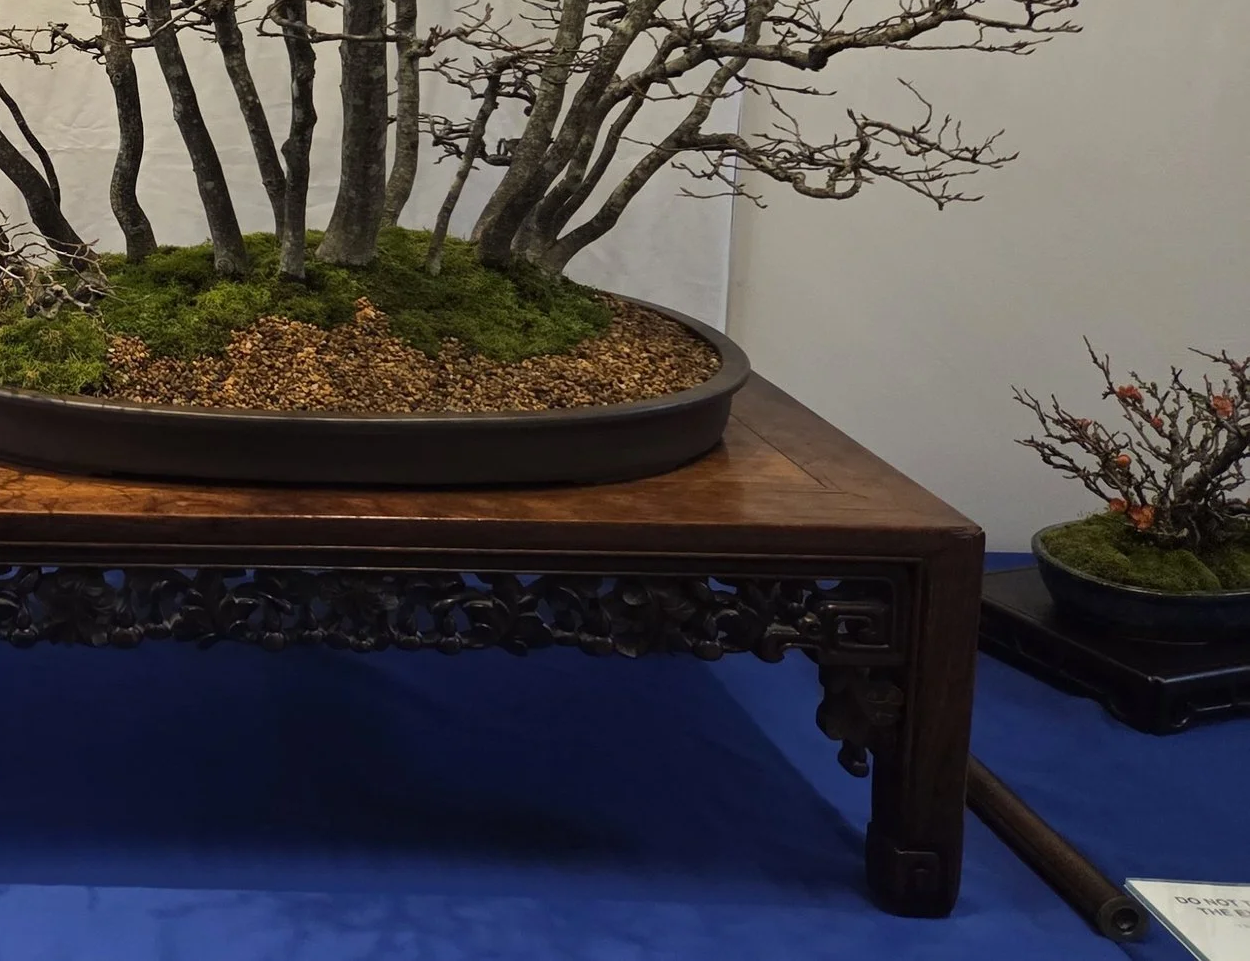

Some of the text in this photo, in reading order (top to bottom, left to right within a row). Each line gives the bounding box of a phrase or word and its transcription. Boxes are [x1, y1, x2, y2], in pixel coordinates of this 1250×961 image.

[1174, 896, 1201, 905] DO
[1202, 898, 1238, 907] NOT
[1196, 907, 1233, 916] THE
